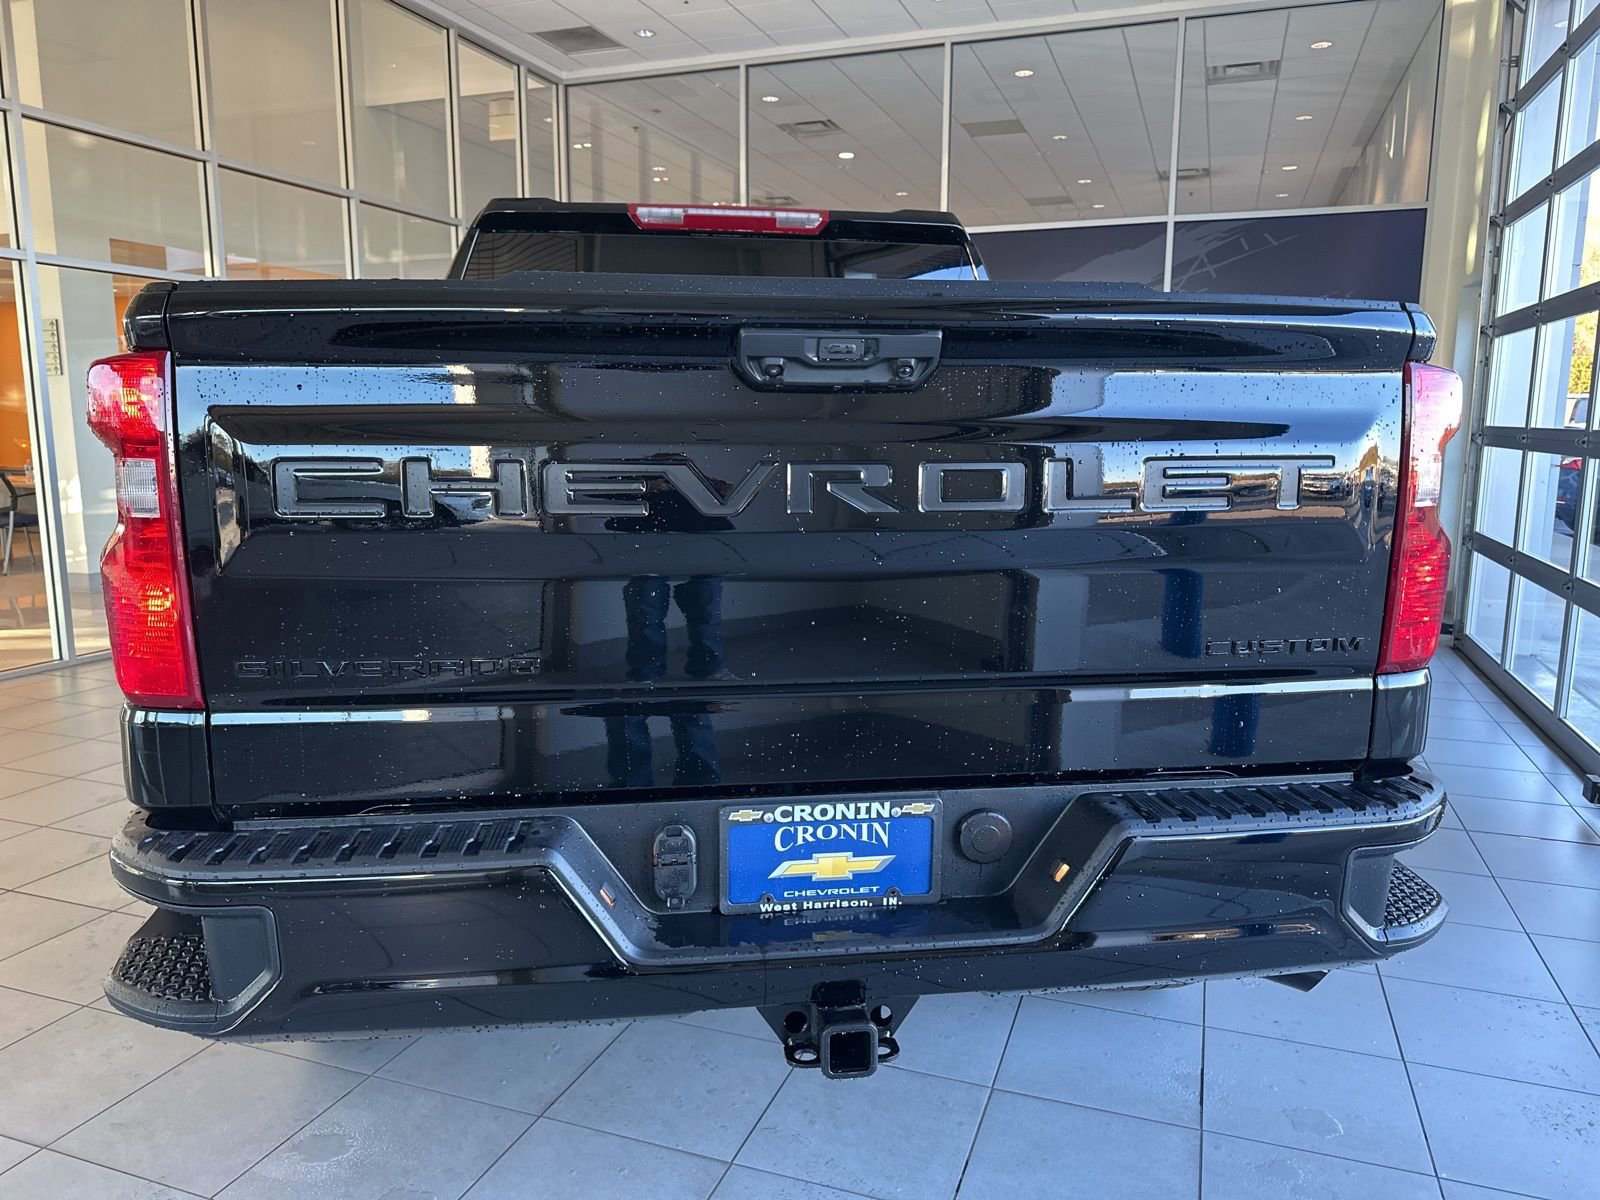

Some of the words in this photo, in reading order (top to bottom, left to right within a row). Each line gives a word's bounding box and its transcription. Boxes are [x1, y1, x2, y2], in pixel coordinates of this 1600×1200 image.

[270, 455, 1336, 518] CHEVROLET
[1205, 636, 1365, 656] CUSTOM
[235, 657, 541, 678] SILVERADO
[774, 801, 891, 823] CRONIN
[774, 822, 891, 852] CRONIN
[783, 886, 880, 898] CHEVROLET
[759, 903, 798, 913] West
[803, 899, 873, 910] Harrison,
[882, 896, 903, 906] IN.
